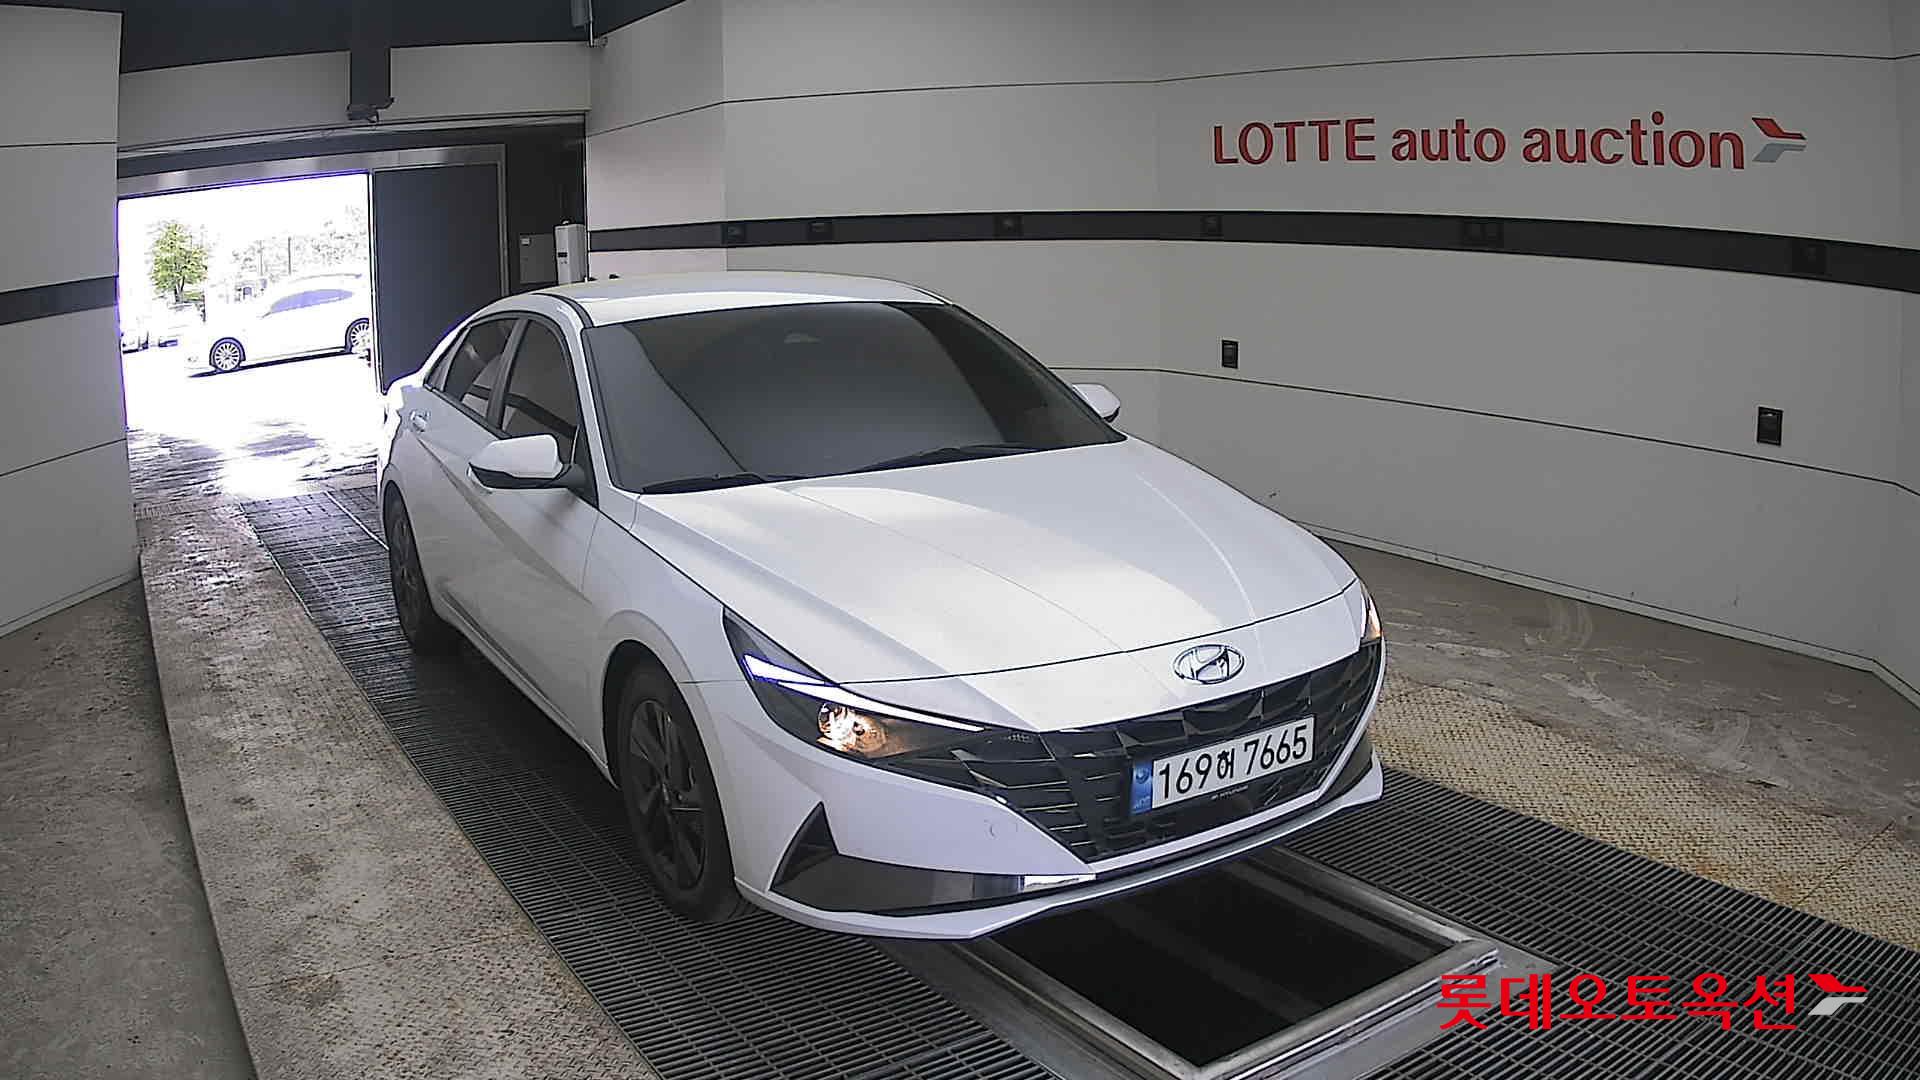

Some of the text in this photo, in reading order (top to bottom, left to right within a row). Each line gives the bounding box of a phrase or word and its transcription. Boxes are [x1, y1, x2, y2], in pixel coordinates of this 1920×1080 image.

[1213, 111, 1745, 169] LOTTE auto auction
[1159, 725, 1307, 799] 169허 7665
